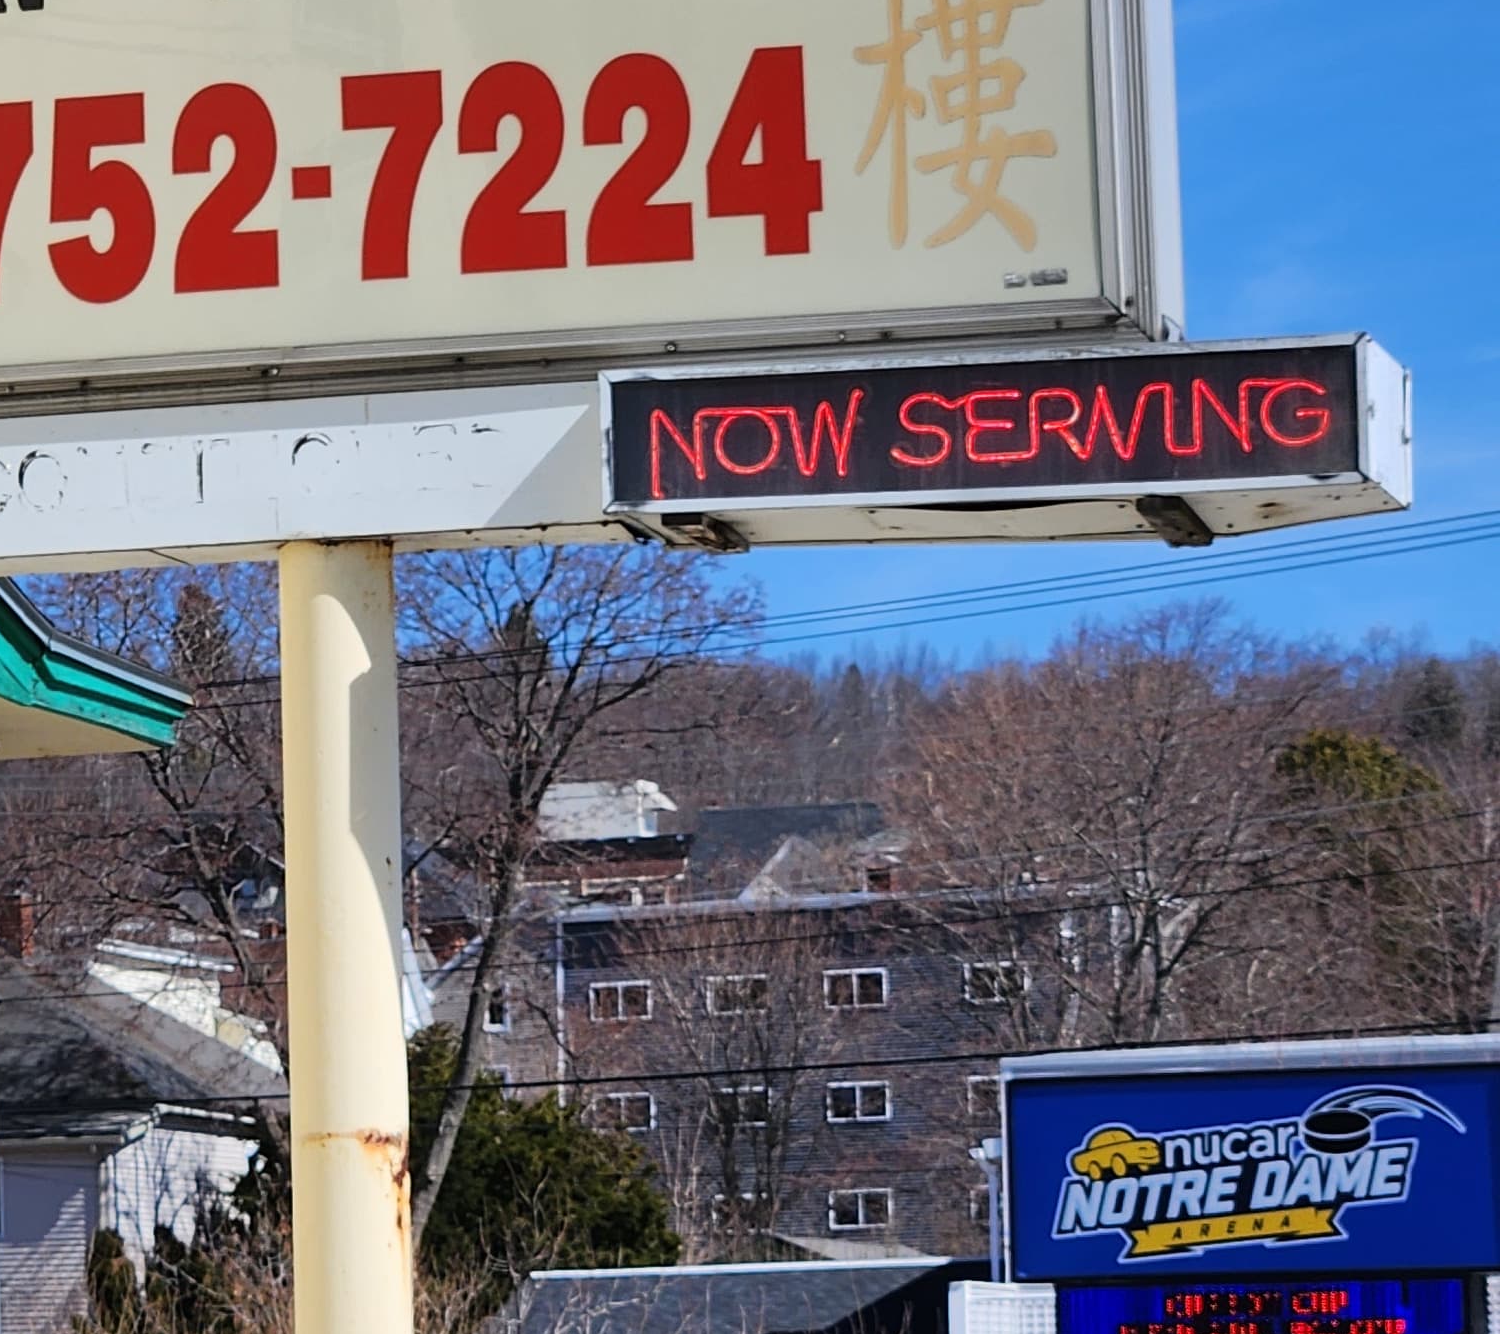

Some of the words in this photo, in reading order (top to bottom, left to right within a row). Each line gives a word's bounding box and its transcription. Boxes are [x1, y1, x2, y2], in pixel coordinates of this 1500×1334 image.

[649, 386, 865, 500] NOW
[889, 376, 1332, 467] SERVING
[1164, 1122, 1297, 1169] nucar
[1059, 1164, 1243, 1232] NOTRE
[1250, 1144, 1410, 1210] DAME
[1171, 1214, 1292, 1241] ARENA
